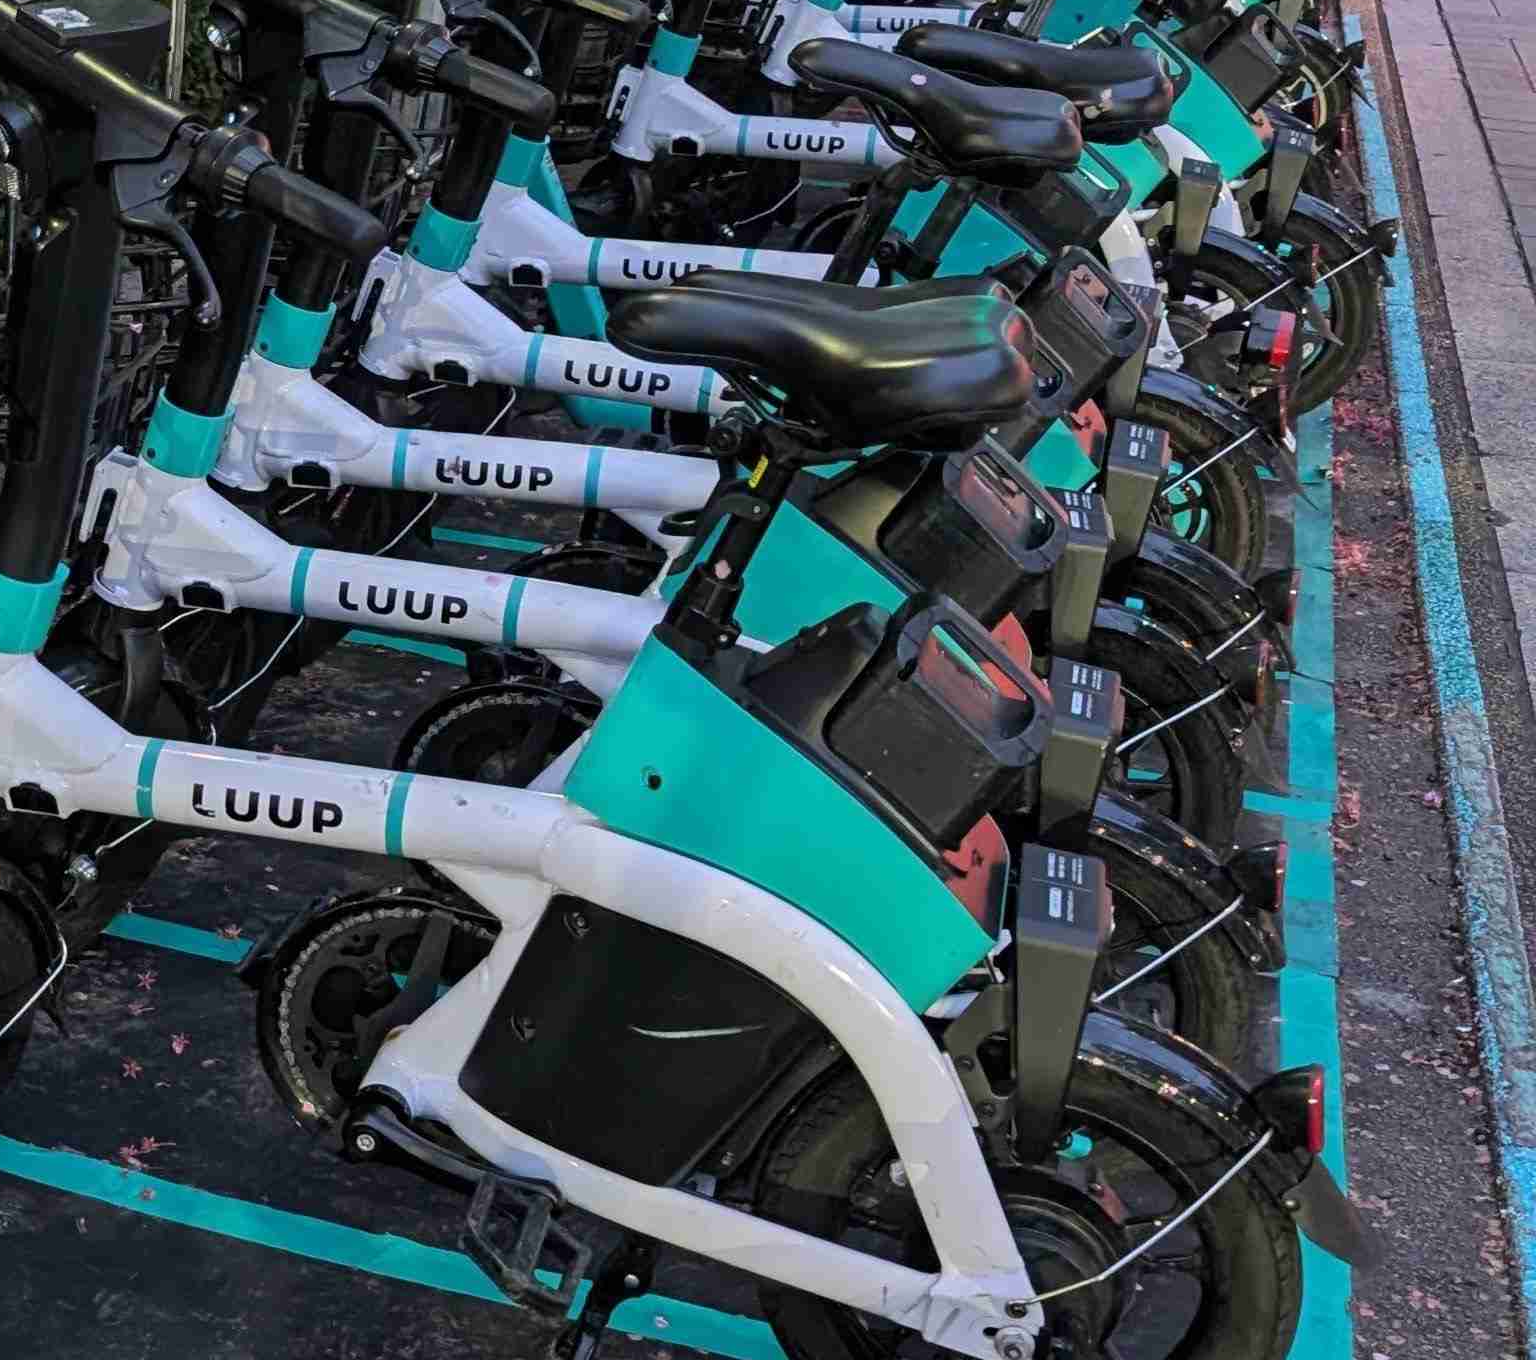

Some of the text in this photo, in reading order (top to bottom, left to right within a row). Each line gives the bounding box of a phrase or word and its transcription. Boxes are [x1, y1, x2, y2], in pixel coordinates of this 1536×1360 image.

[766, 130, 846, 155] LUUP
[623, 259, 713, 281] LUU
[565, 360, 672, 396] LUUP
[435, 457, 554, 492] LUUP
[338, 580, 469, 625] LUUP
[191, 782, 344, 834] LUUP
